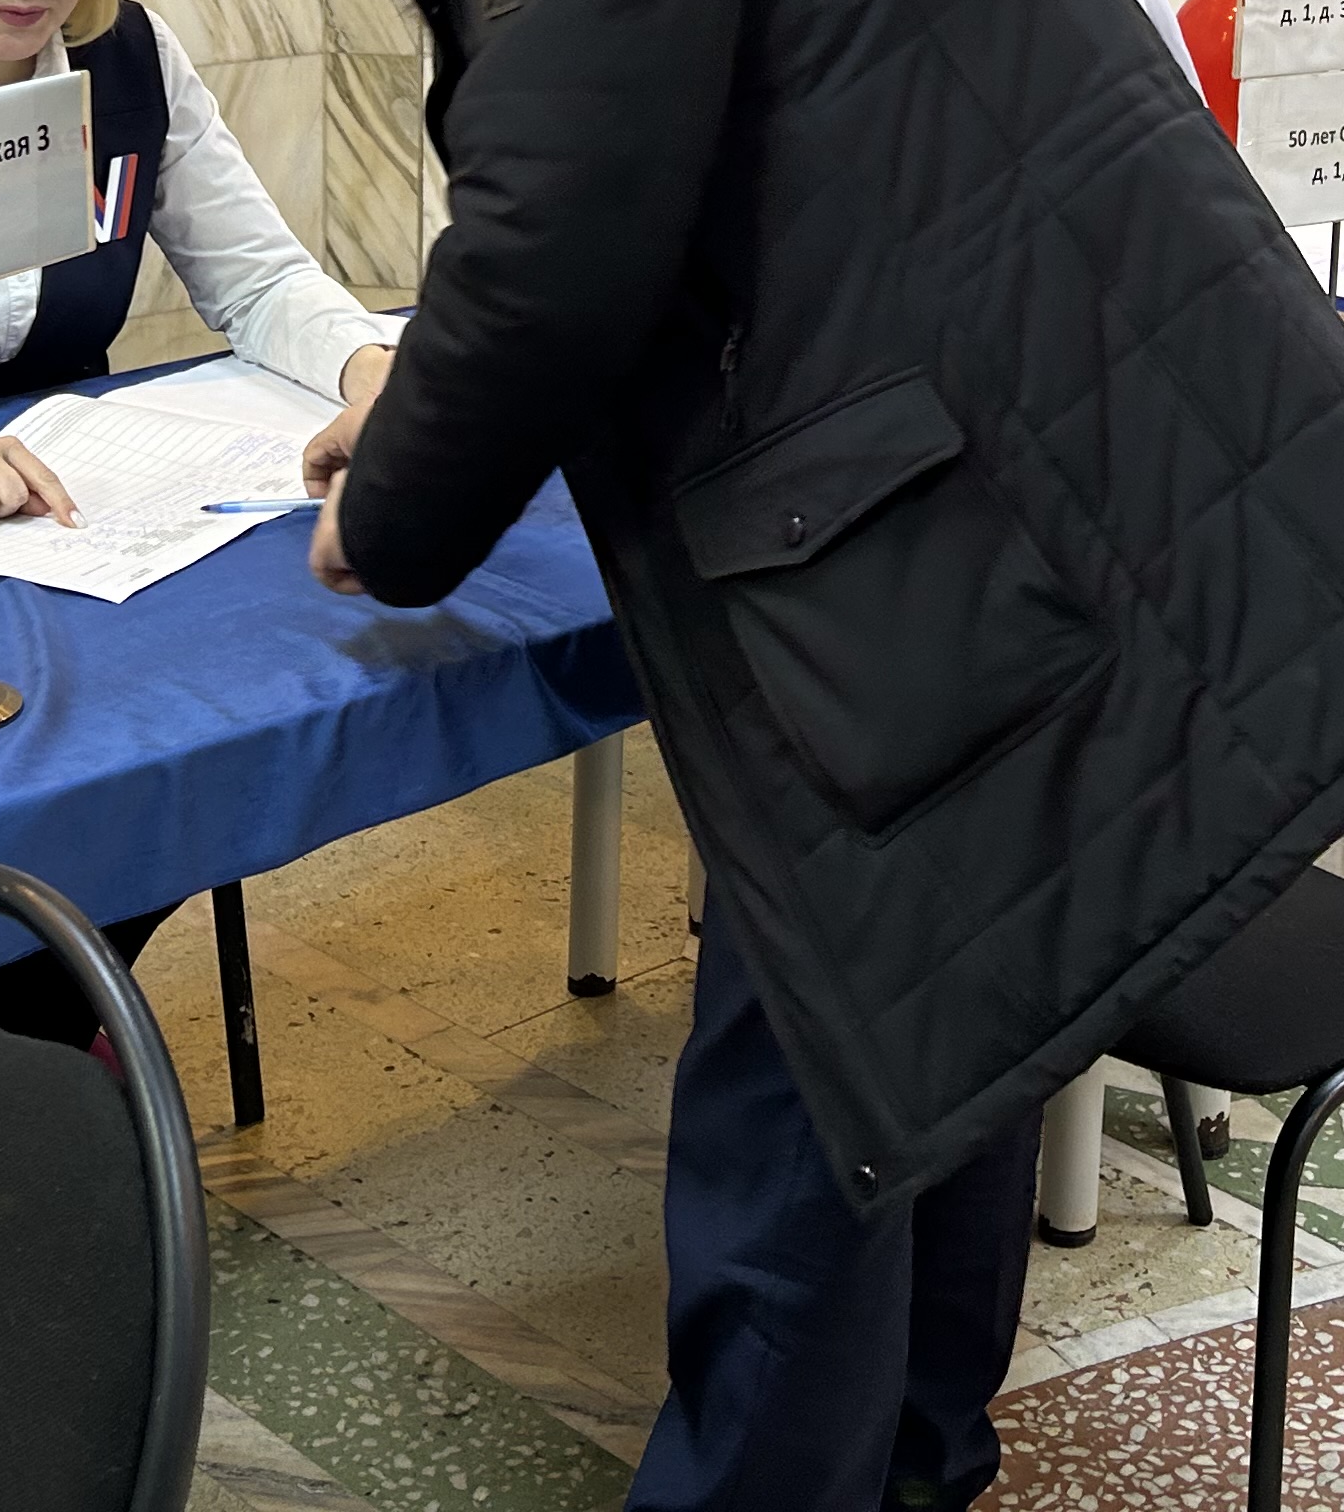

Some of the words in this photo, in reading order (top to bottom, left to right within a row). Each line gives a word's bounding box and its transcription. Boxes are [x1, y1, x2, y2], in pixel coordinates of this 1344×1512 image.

[1280, 7, 1297, 27] д.
[1303, 5, 1316, 25] 1,
[1319, 6, 1335, 24] д.
[37, 124, 51, 152] 3
[1288, 129, 1307, 148] 50
[1310, 129, 1337, 146] лет
[1312, 165, 1329, 184] д.
